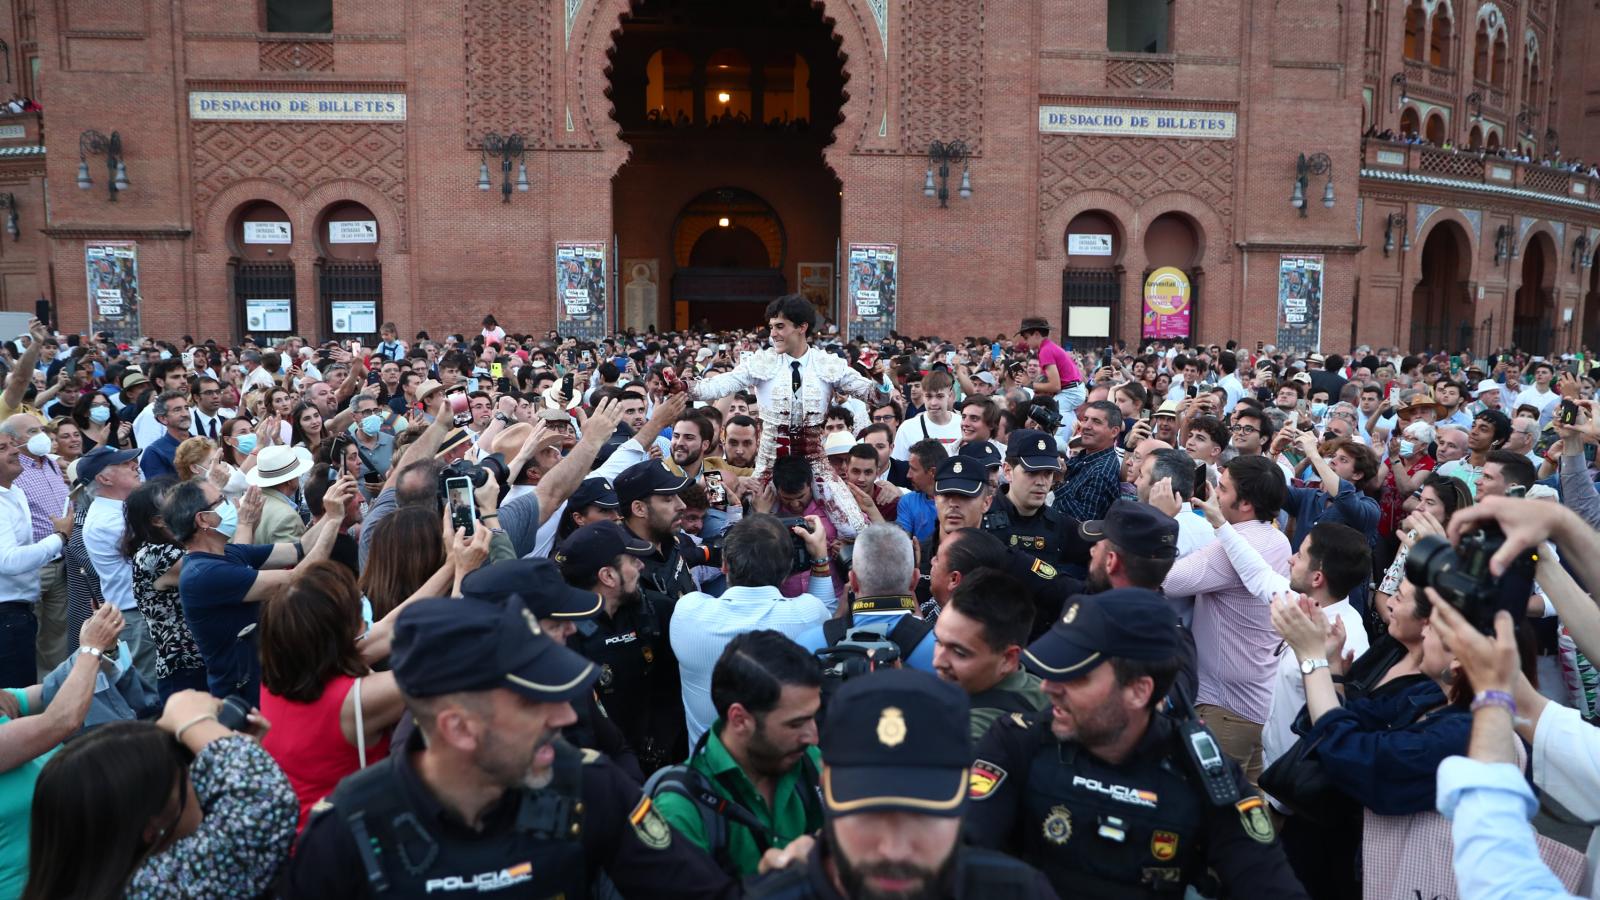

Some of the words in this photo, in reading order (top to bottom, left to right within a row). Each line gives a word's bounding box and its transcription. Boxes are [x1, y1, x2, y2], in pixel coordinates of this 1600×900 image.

[200, 99, 282, 112] DESPACHO
[289, 100, 310, 112] DE
[318, 100, 395, 113] BILLETES
[1048, 113, 1123, 127] DESPACHO
[1130, 116, 1149, 128] DE
[1157, 117, 1226, 130] BILLETES
[853, 601, 875, 609] Nikon
[1072, 775, 1140, 799] POLICIA
[425, 869, 512, 894] POLICIA
